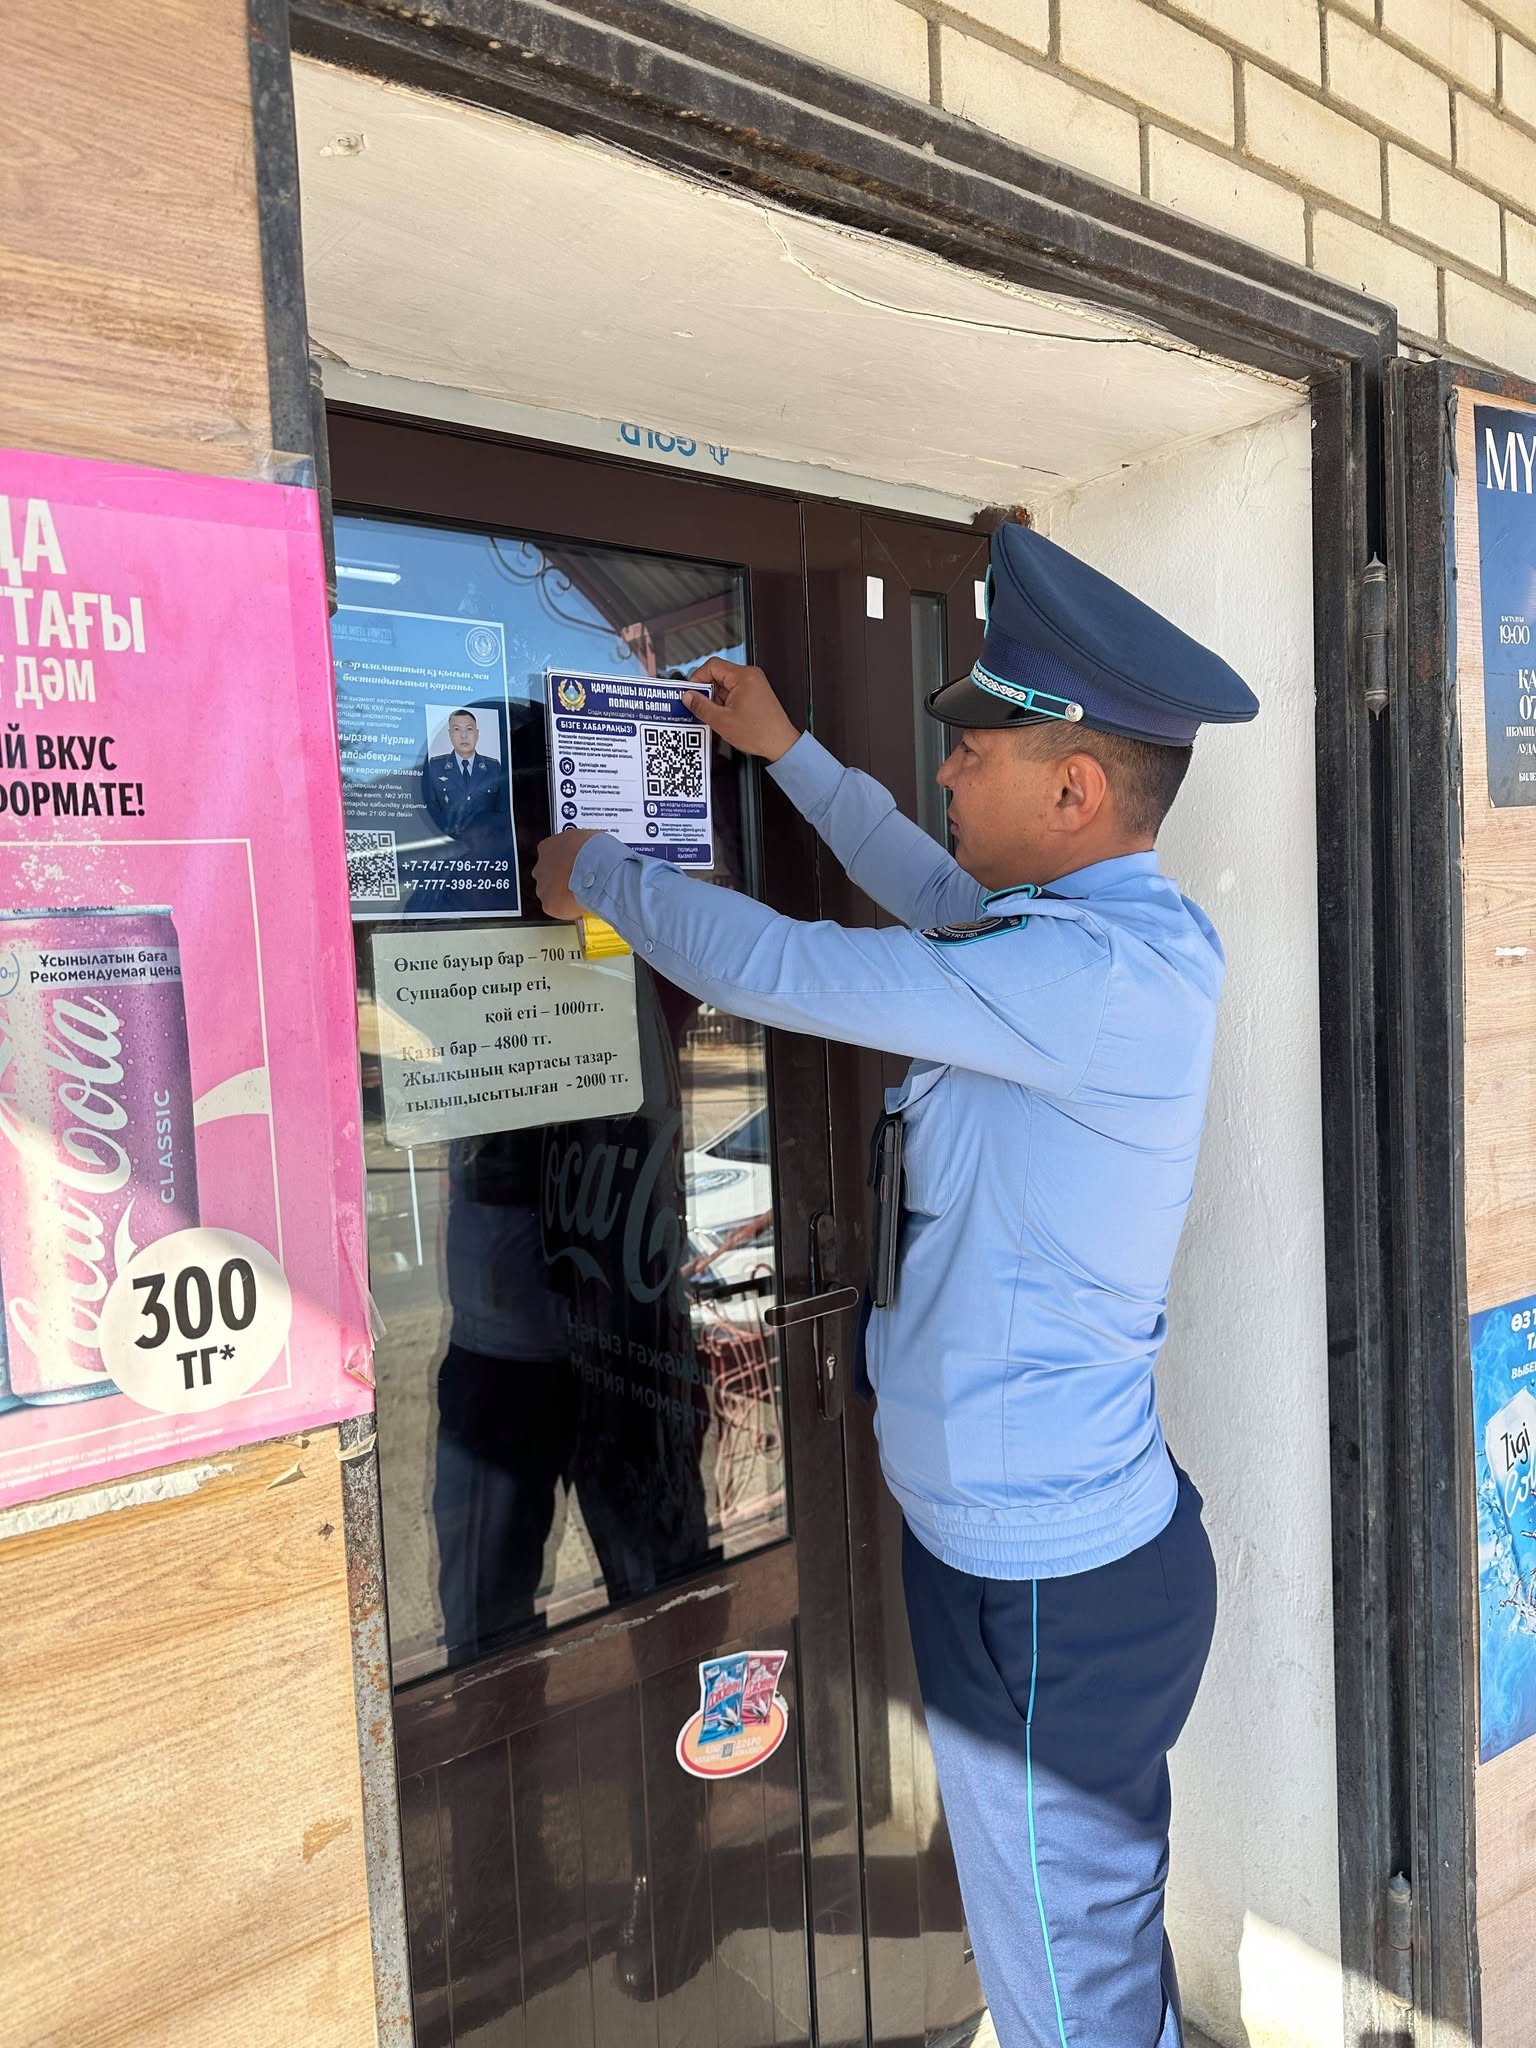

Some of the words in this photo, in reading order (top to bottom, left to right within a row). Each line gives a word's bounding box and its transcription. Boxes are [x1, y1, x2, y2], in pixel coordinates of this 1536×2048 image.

[0, 587, 146, 654] ТАҒЫ
[1499, 624, 1531, 645] 19:00
[15, 655, 97, 710] ДӘМ
[590, 682, 637, 697] ҚАРМАҚШЫ
[638, 685, 685, 701] АУДАНЫНЫ
[608, 697, 644, 711] ПОЛИЦИЯ
[644, 700, 671, 713] БӨЛІМІ
[560, 720, 581, 730] БІЗГЕ
[582, 722, 633, 734] ХАБАРЛАҢЫЗ!
[0, 723, 28, 769] Й
[36, 735, 118, 771] ВКУС
[402, 859, 509, 874] +7-747-796-77-29
[403, 878, 510, 892] +7-777-398-20-66
[39, 952, 136, 968] Ұсынылатын
[138, 950, 168, 963] баға
[394, 956, 439, 973] Өкпе
[443, 951, 494, 971] бауыр
[497, 951, 524, 971] бар
[540, 947, 565, 962] 700
[30, 967, 147, 984] Рекомендуемая
[149, 965, 182, 978] цена
[396, 980, 477, 1005] Супнабор
[481, 981, 522, 1000] сиыр
[526, 976, 551, 993] еті,
[485, 1004, 513, 1024] қой
[516, 1003, 537, 1020] еті
[554, 1000, 604, 1016] 1000тг.
[401, 1044, 445, 1064] Қазы
[449, 1041, 477, 1060] бар
[494, 1033, 528, 1049] 4800
[532, 1033, 552, 1046] тг.
[403, 1064, 504, 1089] Жылқының
[508, 1055, 571, 1076] қартасы
[574, 1048, 618, 1068] тазар-
[575, 1072, 606, 1090] 2000
[609, 1071, 629, 1085] тг.
[155, 1088, 176, 1205] CLASSIC
[132, 1257, 257, 1350] 300
[1511, 1360, 1536, 1380] ВЫБЕ
[1500, 1421, 1531, 1472] Zigi
